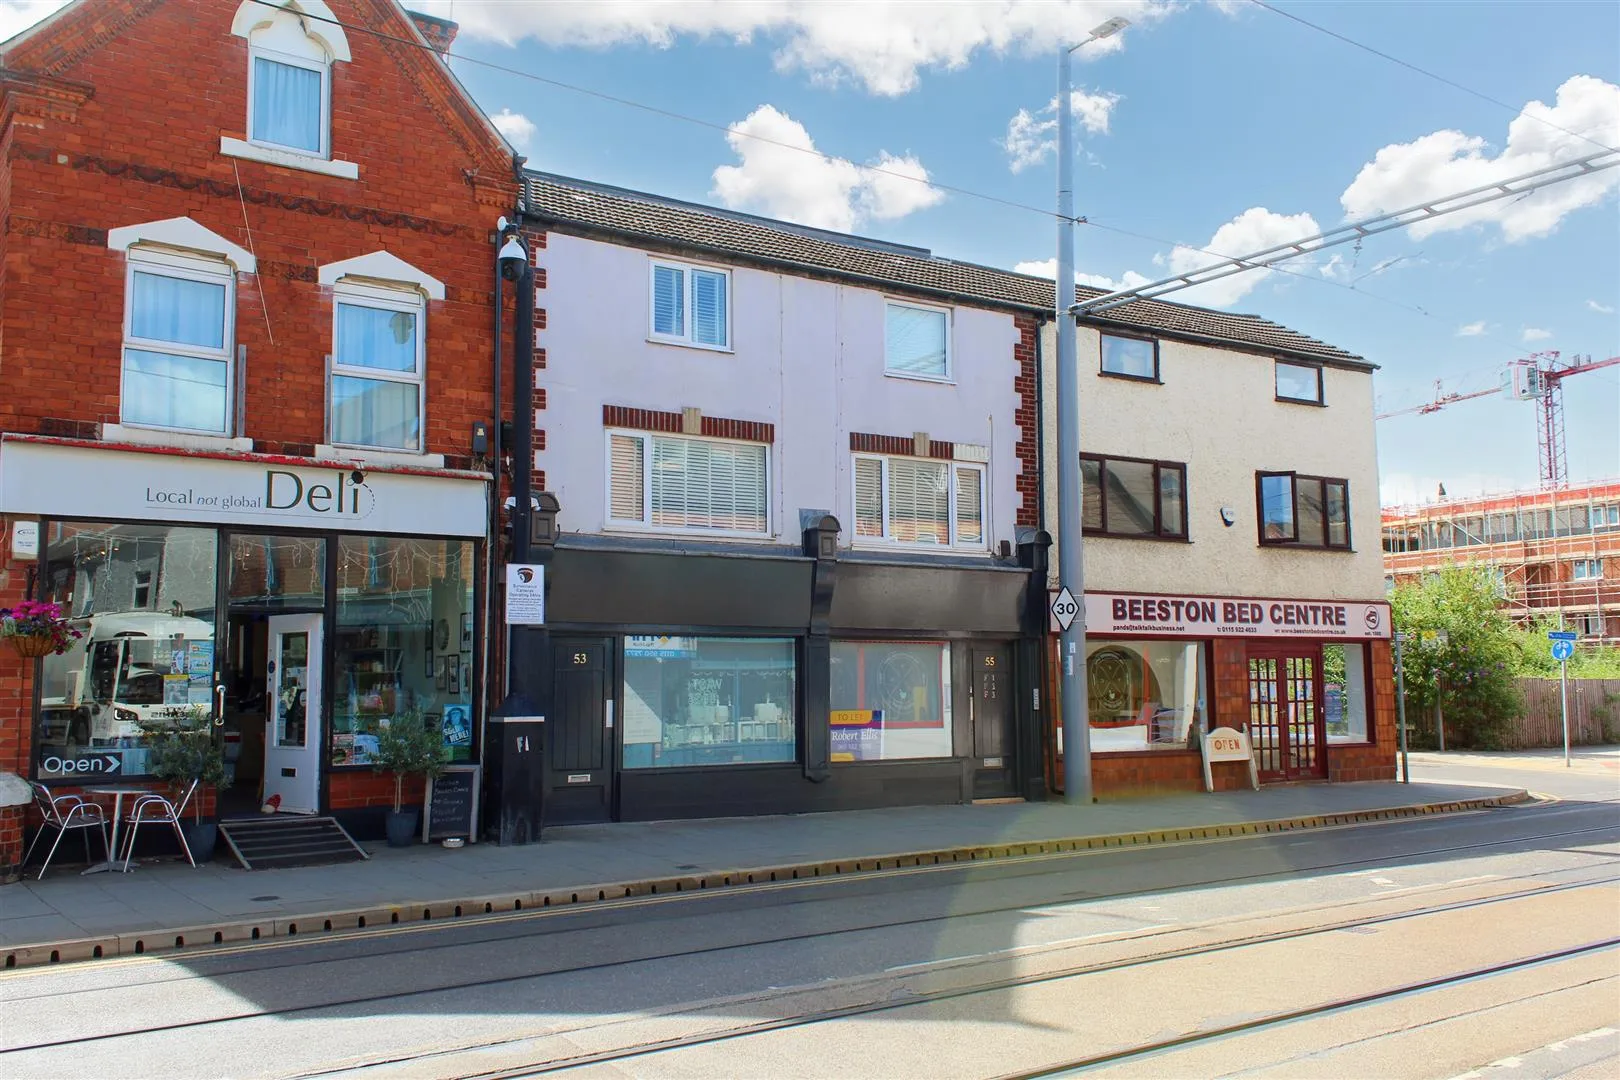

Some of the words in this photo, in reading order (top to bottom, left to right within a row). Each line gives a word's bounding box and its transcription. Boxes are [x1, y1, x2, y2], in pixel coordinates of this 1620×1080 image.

[146, 487, 192, 504] Local
[197, 495, 218, 506] not
[222, 495, 261, 510] global
[266, 470, 363, 514] Deli
[1056, 602, 1075, 615] 30
[1112, 598, 1216, 623] BEESTON
[1223, 602, 1264, 625] BED
[1269, 603, 1346, 626] CENTRE
[574, 653, 586, 664] 53
[985, 656, 995, 666] 55
[838, 713, 848, 721] TO
[850, 713, 863, 721] LET
[831, 727, 858, 741] Robert
[861, 727, 878, 741] Ellis
[1215, 739, 1240, 750] OPEN
[44, 756, 103, 776] Open
